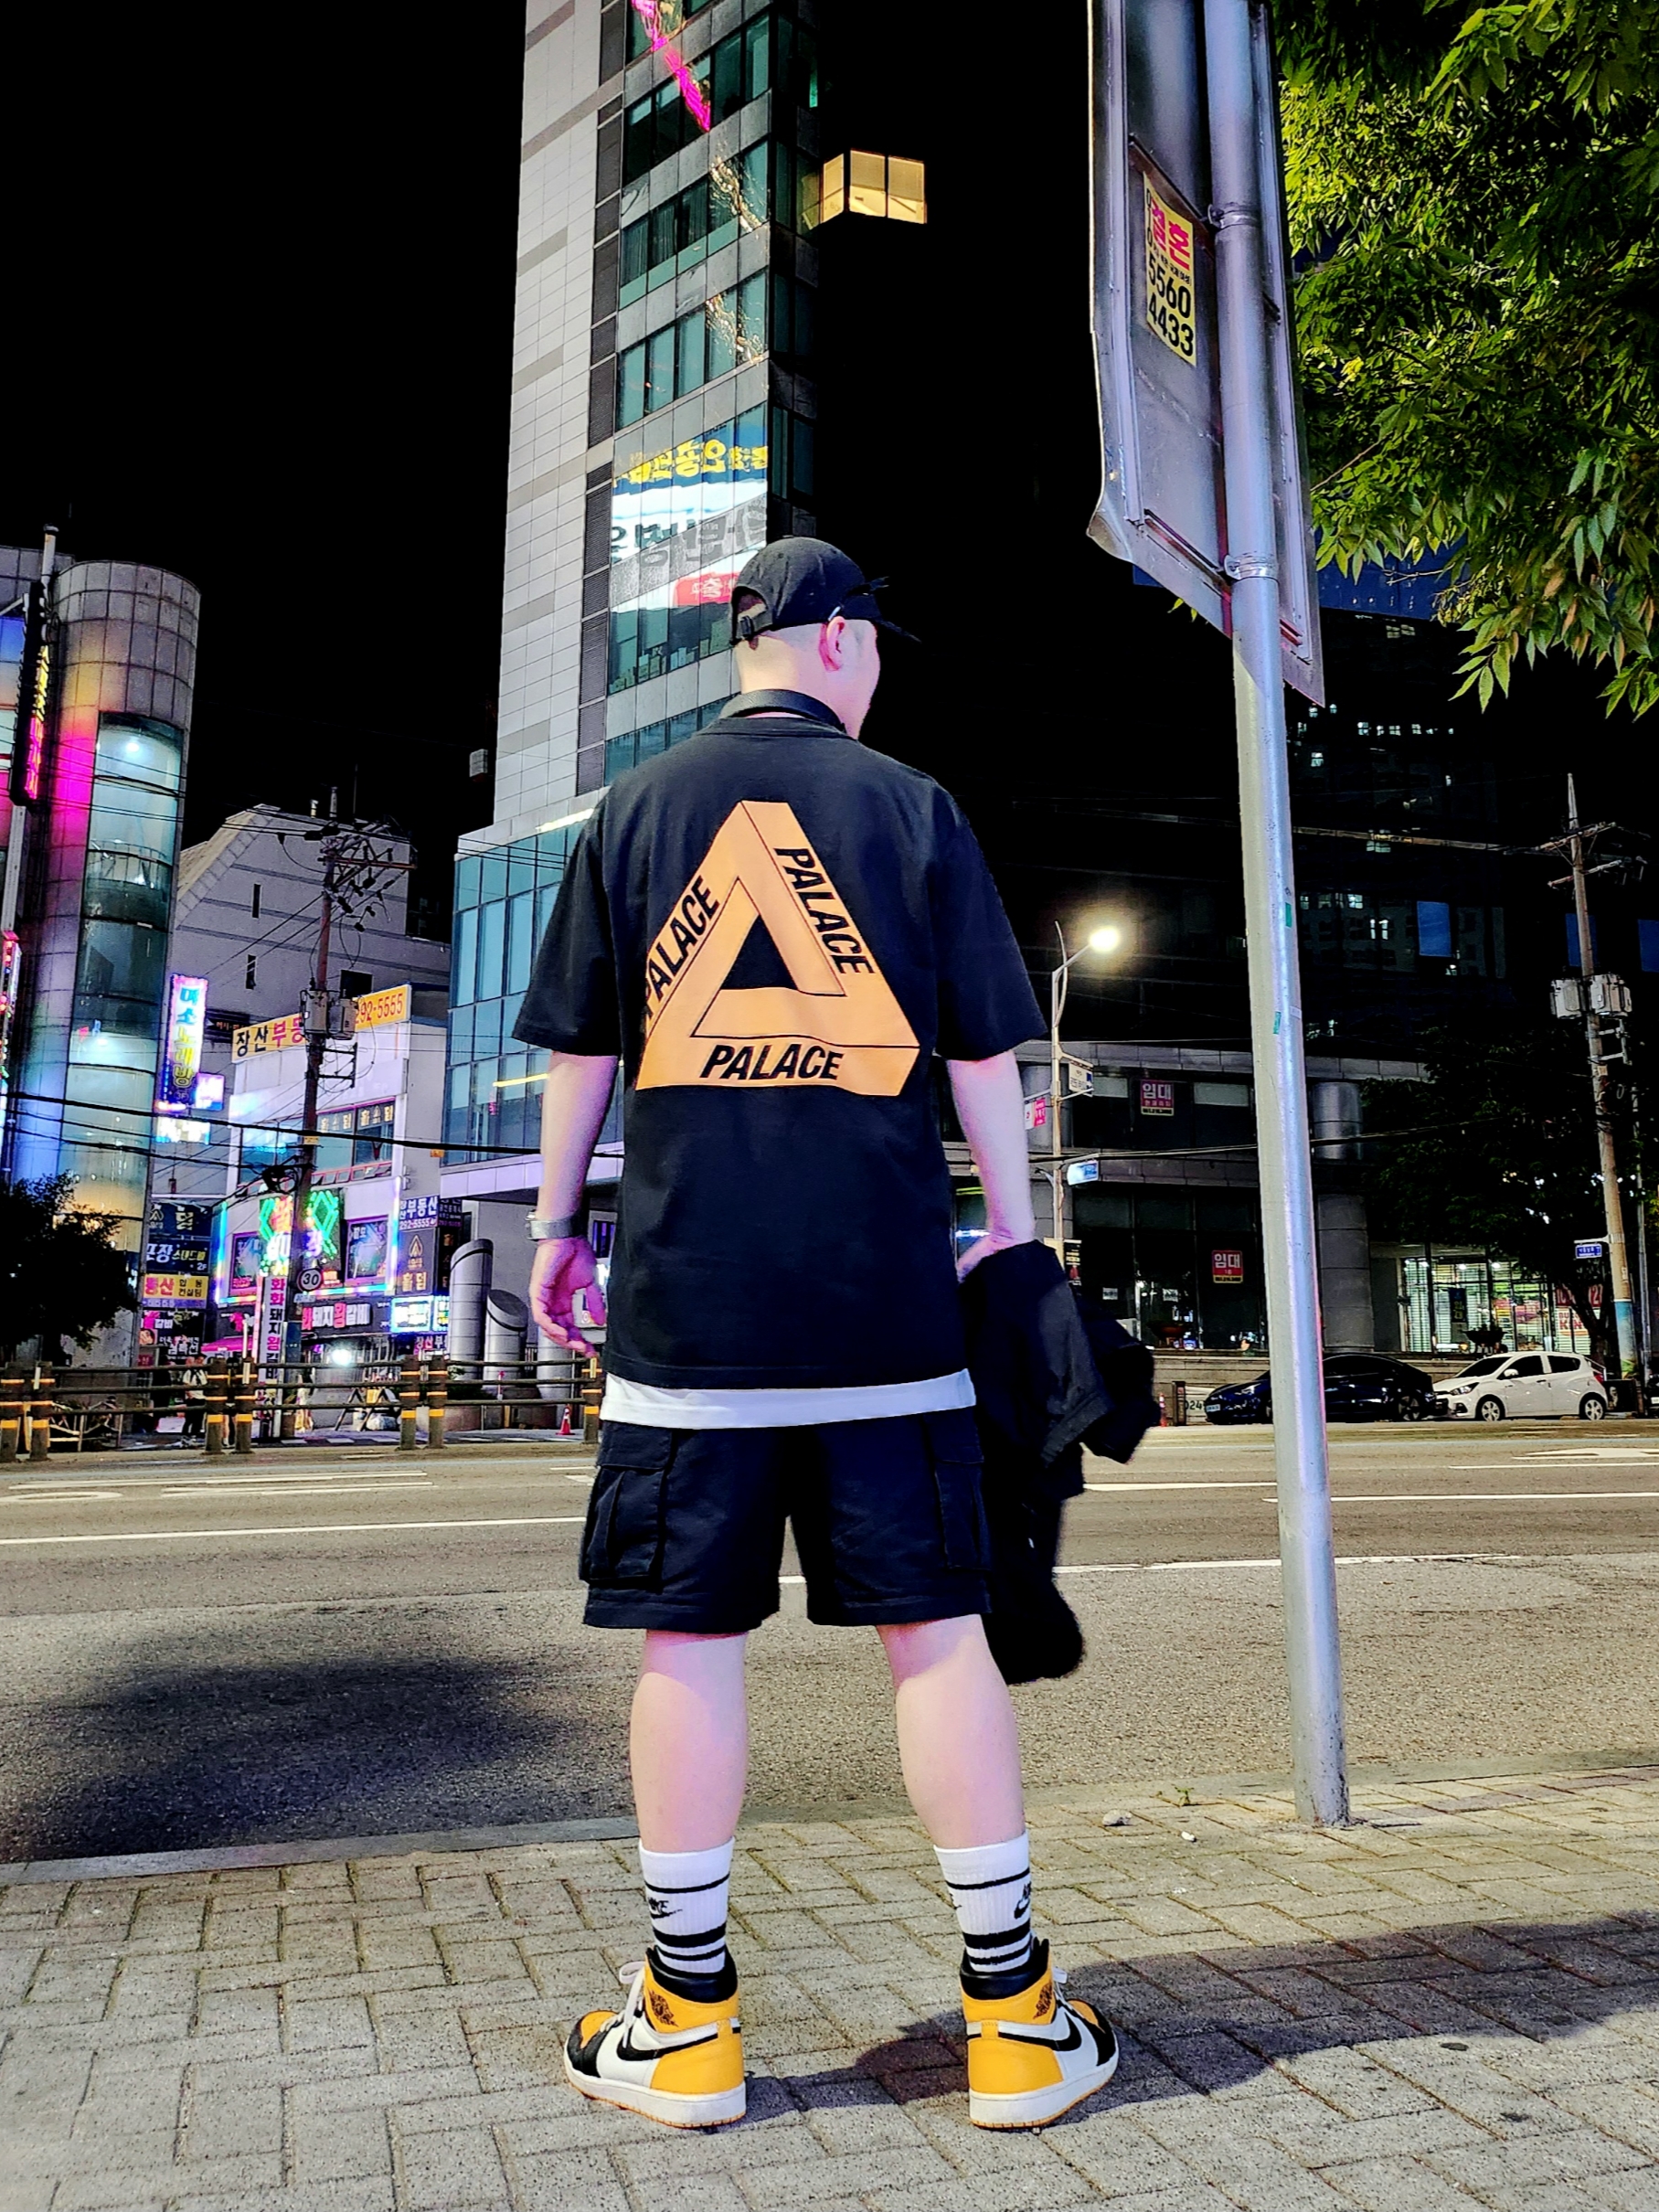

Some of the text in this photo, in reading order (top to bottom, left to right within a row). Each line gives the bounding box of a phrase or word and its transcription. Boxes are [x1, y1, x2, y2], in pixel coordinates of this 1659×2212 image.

[1149, 250, 1192, 319] 5560
[1149, 292, 1194, 357] 4433
[773, 847, 875, 974] PALACE
[699, 1044, 845, 1080] PALACE
[1143, 1083, 1172, 1101] 임대
[407, 1196, 438, 1218] 부동산
[1214, 1253, 1240, 1269] 임대
[303, 1272, 320, 1286] 30
